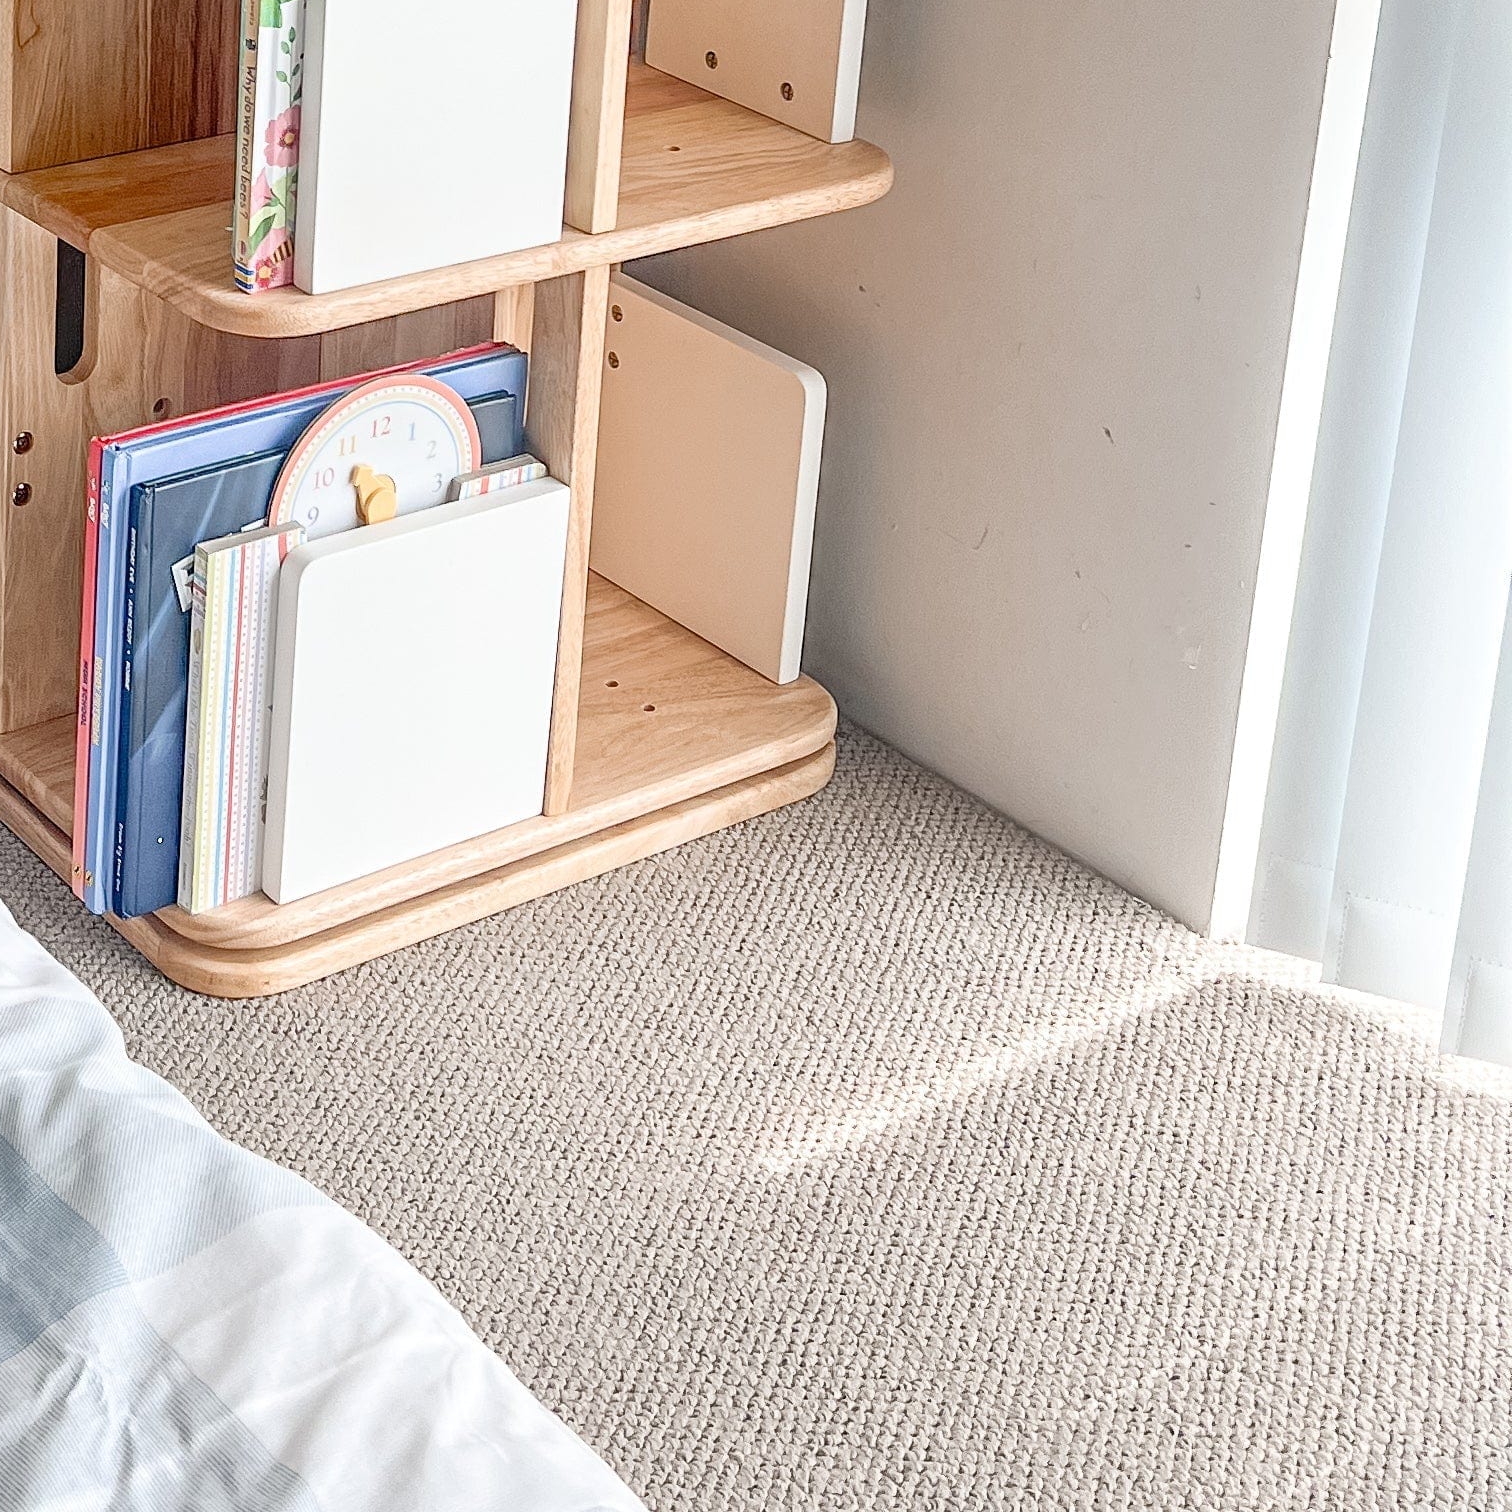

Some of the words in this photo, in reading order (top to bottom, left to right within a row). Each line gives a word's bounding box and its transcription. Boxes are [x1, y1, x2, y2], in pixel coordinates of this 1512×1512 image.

[242, 66, 256, 93] Why
[245, 96, 254, 112] do
[243, 113, 252, 134] we
[241, 138, 251, 173] need
[239, 173, 251, 219] bees?
[370, 416, 391, 438] 12
[408, 422, 416, 441] 1
[338, 435, 357, 457] 11
[426, 440, 437, 459] 2
[313, 467, 335, 489] 10
[432, 473, 442, 493] 3
[308, 506, 319, 526] 9
